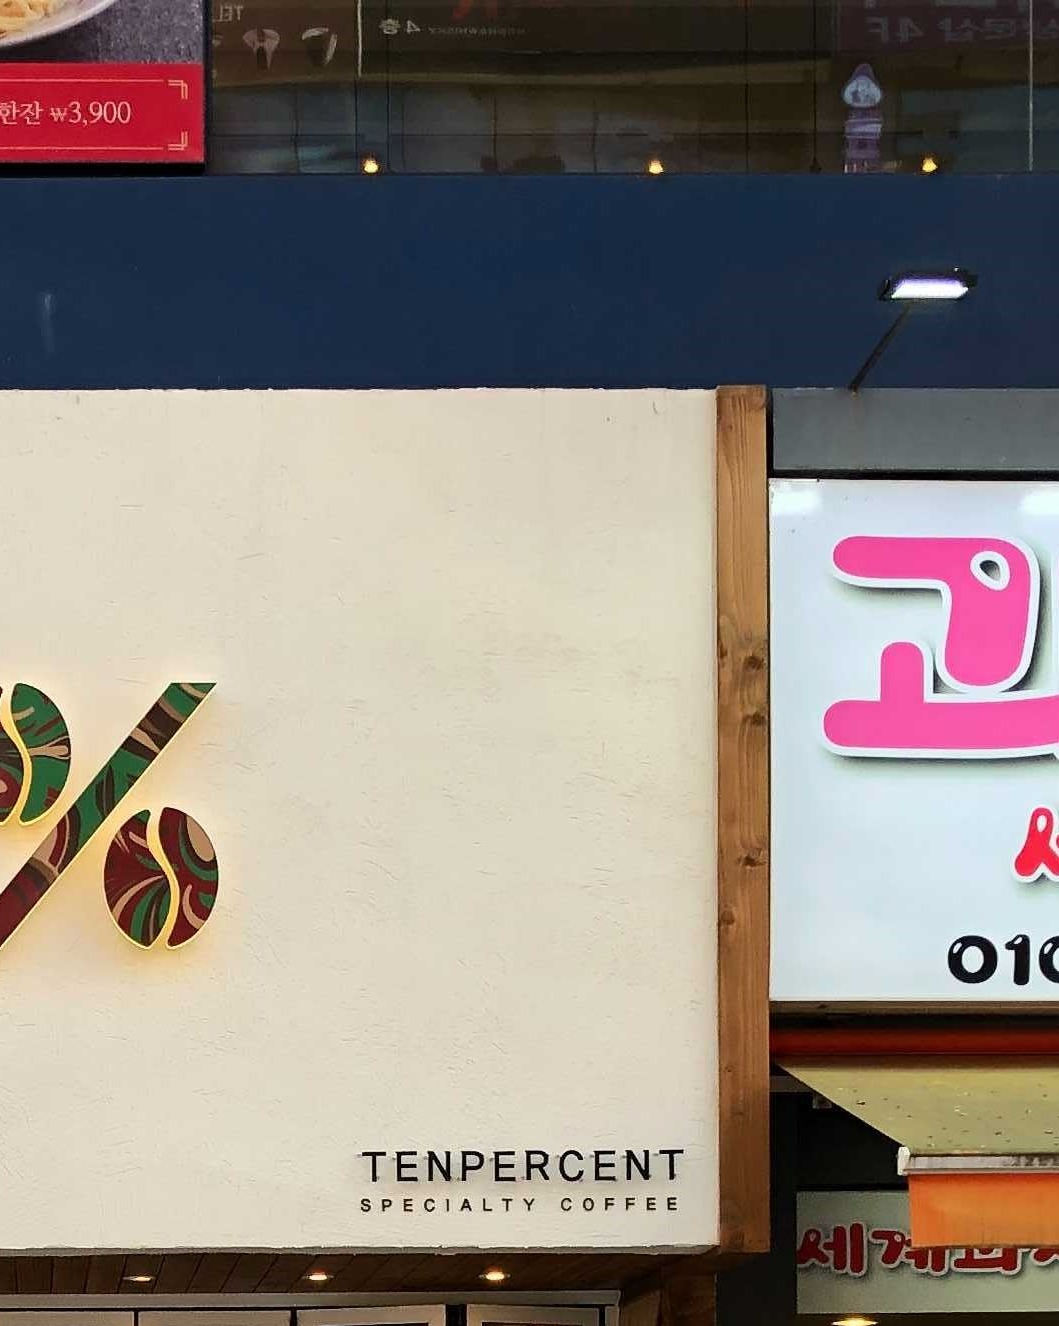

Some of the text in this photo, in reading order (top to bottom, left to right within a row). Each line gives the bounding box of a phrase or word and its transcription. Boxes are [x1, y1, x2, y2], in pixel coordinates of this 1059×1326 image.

[361, 1149, 685, 1183] TENPERCENT
[360, 1197, 678, 1213] SPECIALTY COFFEE
